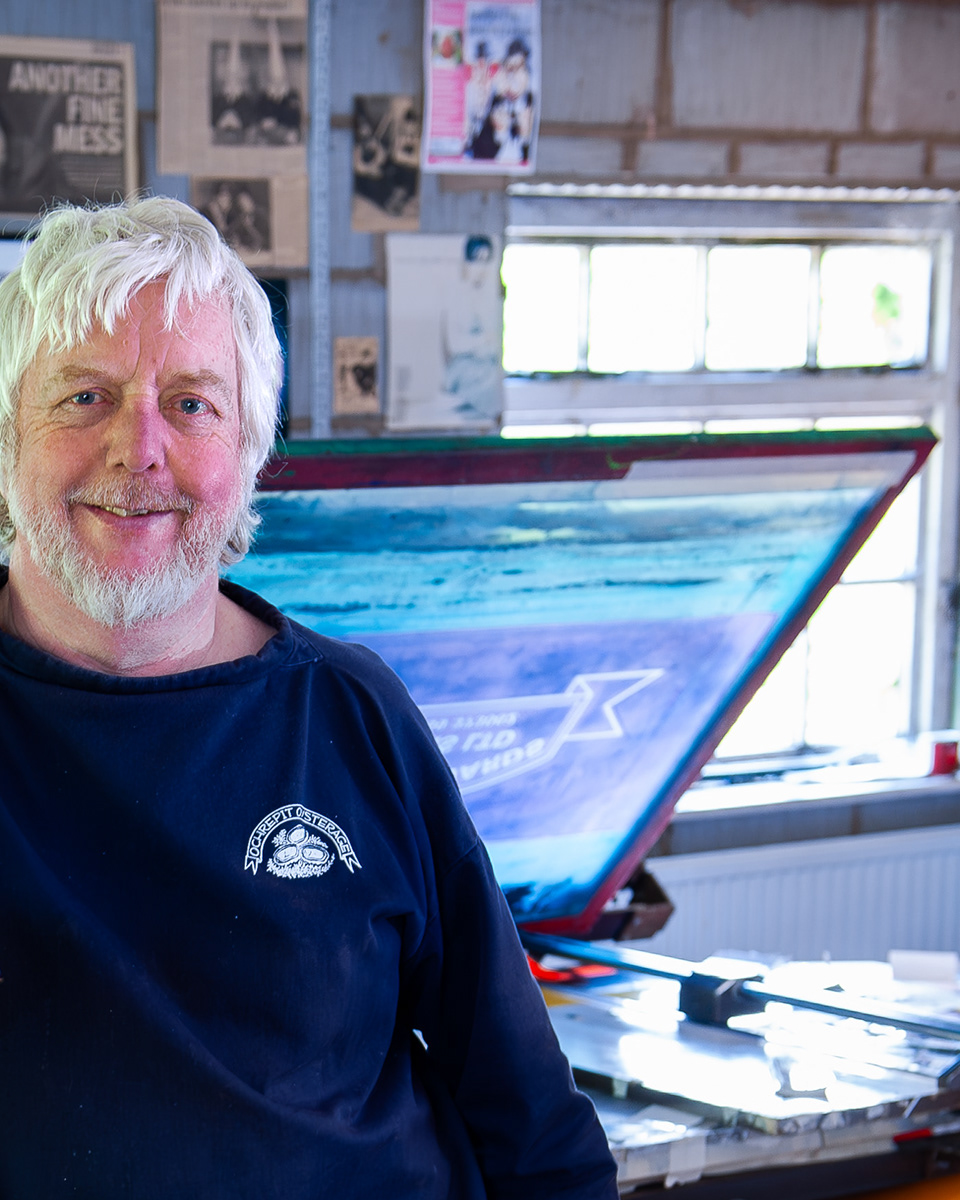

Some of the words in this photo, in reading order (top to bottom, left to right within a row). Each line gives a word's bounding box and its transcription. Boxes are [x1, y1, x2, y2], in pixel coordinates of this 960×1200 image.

[8, 61, 122, 94] ANOTHER
[66, 94, 122, 123] FINE
[53, 122, 122, 155] MESS
